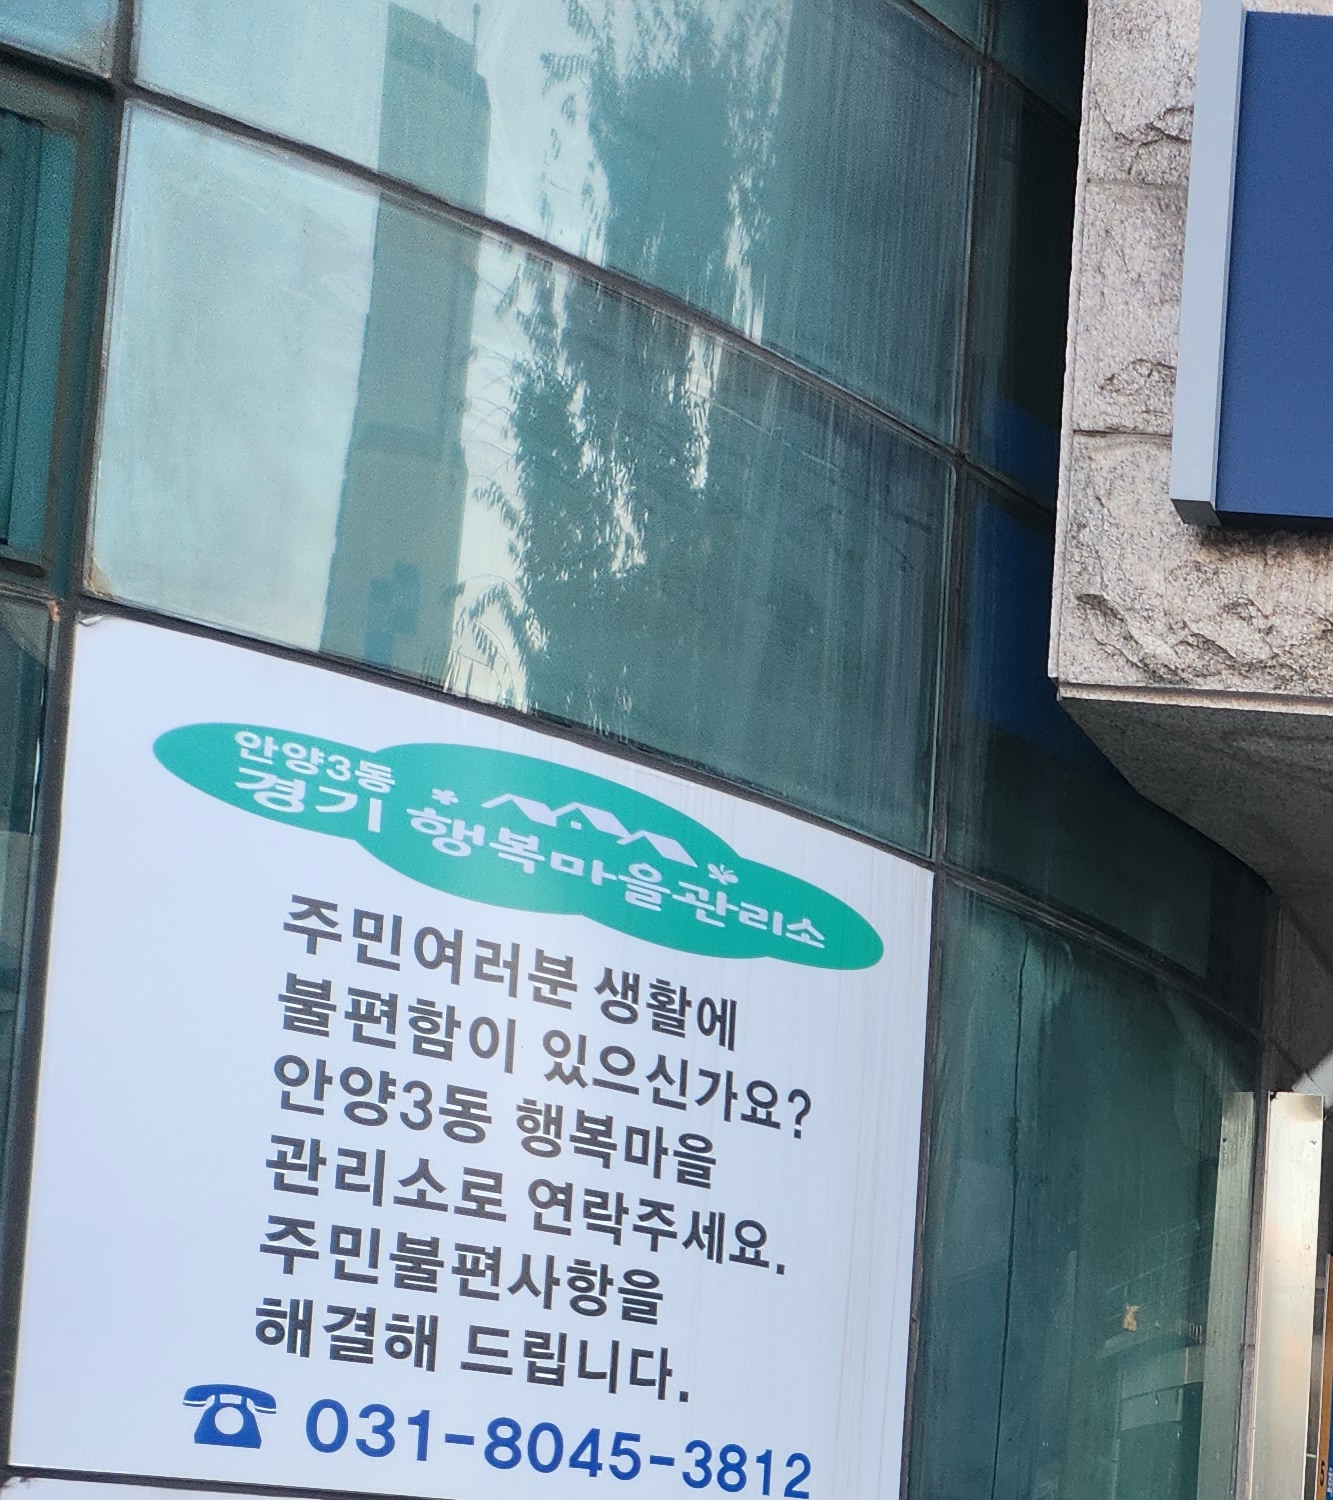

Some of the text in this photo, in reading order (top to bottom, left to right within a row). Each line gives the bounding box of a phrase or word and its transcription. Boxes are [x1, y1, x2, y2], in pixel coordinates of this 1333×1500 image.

[234, 729, 396, 794] 안양3동
[234, 767, 826, 949] 경기 행복마을관리소
[283, 893, 738, 1051] 주민여러분 생활에
[273, 1054, 717, 1190] 안양3동 행복마을
[278, 972, 812, 1139] 불편함이 있으신가요?
[259, 1213, 665, 1326] 주민불편사항을
[265, 1134, 786, 1276] 관리소로 연락주세요.
[255, 1297, 690, 1403] 해결해 드립니다.
[305, 1397, 812, 1500] 031-8045-3812
